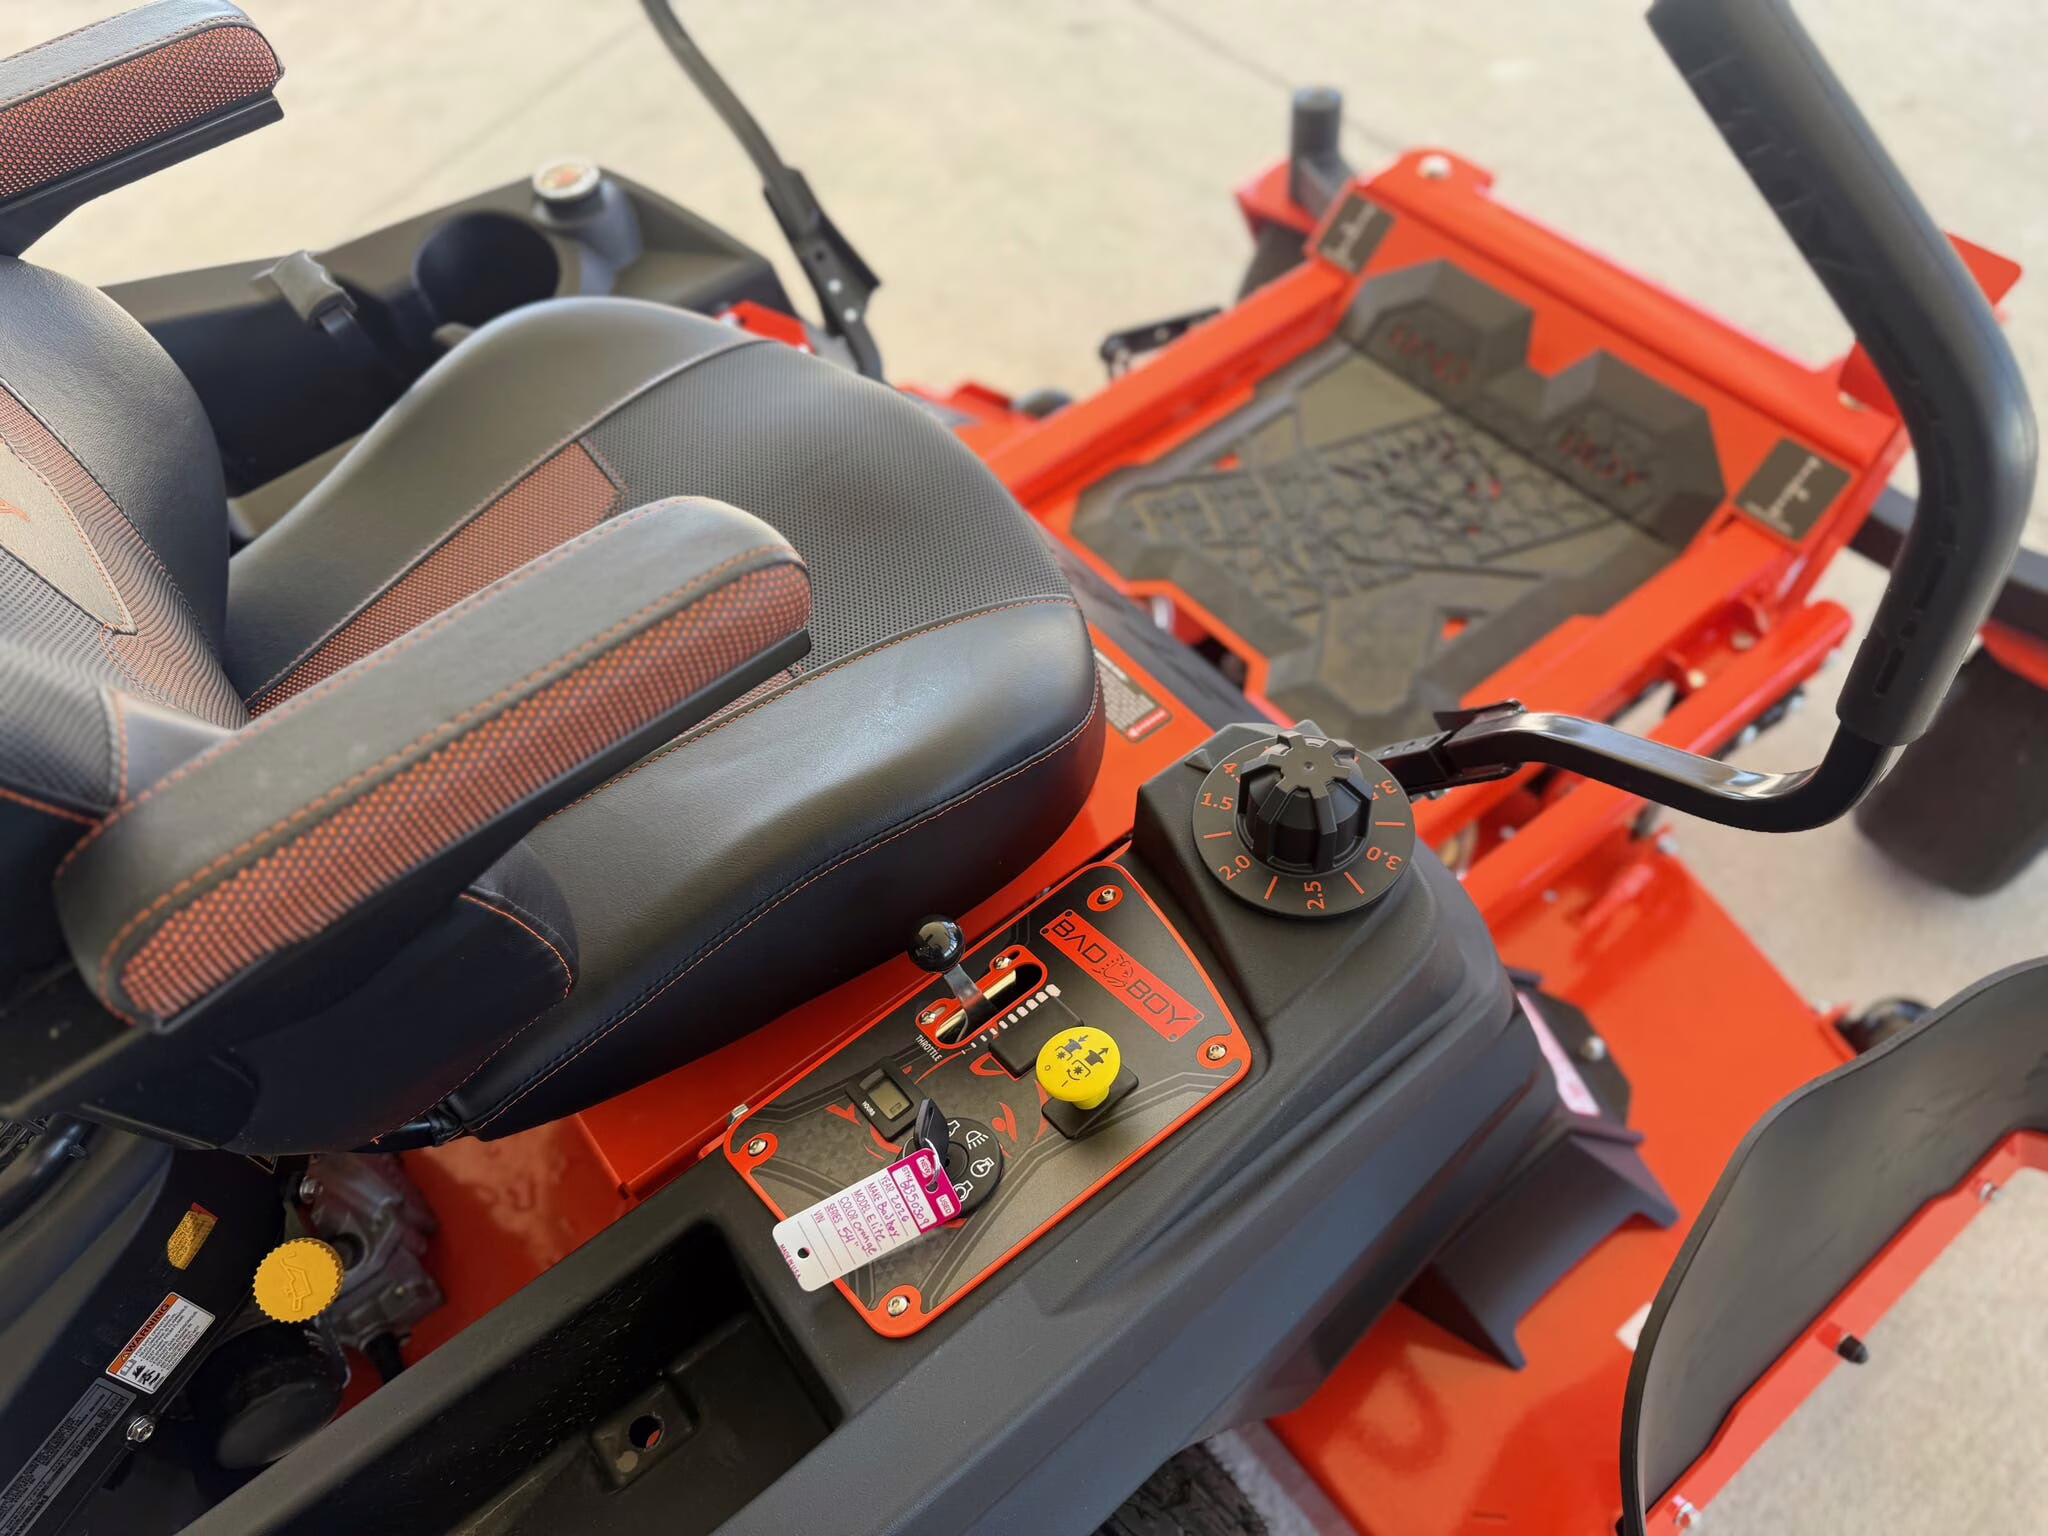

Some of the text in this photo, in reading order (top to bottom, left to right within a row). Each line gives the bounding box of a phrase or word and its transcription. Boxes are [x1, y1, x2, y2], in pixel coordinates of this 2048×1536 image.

[1223, 762, 1240, 784] 4.
[1201, 792, 1234, 811] 1.5
[1218, 855, 1251, 881] 2.0
[1366, 847, 1402, 871] 3.0
[1304, 880, 1326, 911] 2.5
[1052, 919, 1191, 1025] BAD BOY
[915, 1034, 942, 1062] THROTTLE
[867, 1182, 882, 1202] MAKE
[881, 1175, 895, 1194] YEAR
[814, 1209, 825, 1223] VIN
[827, 1203, 843, 1224] SERIES
[840, 1196, 858, 1220] COLOR
[854, 1189, 885, 1241] MODEL Elite
[939, 1196, 952, 1214] USED
[780, 1243, 792, 1259] MADE
[127, 1303, 170, 1352] WARNING
